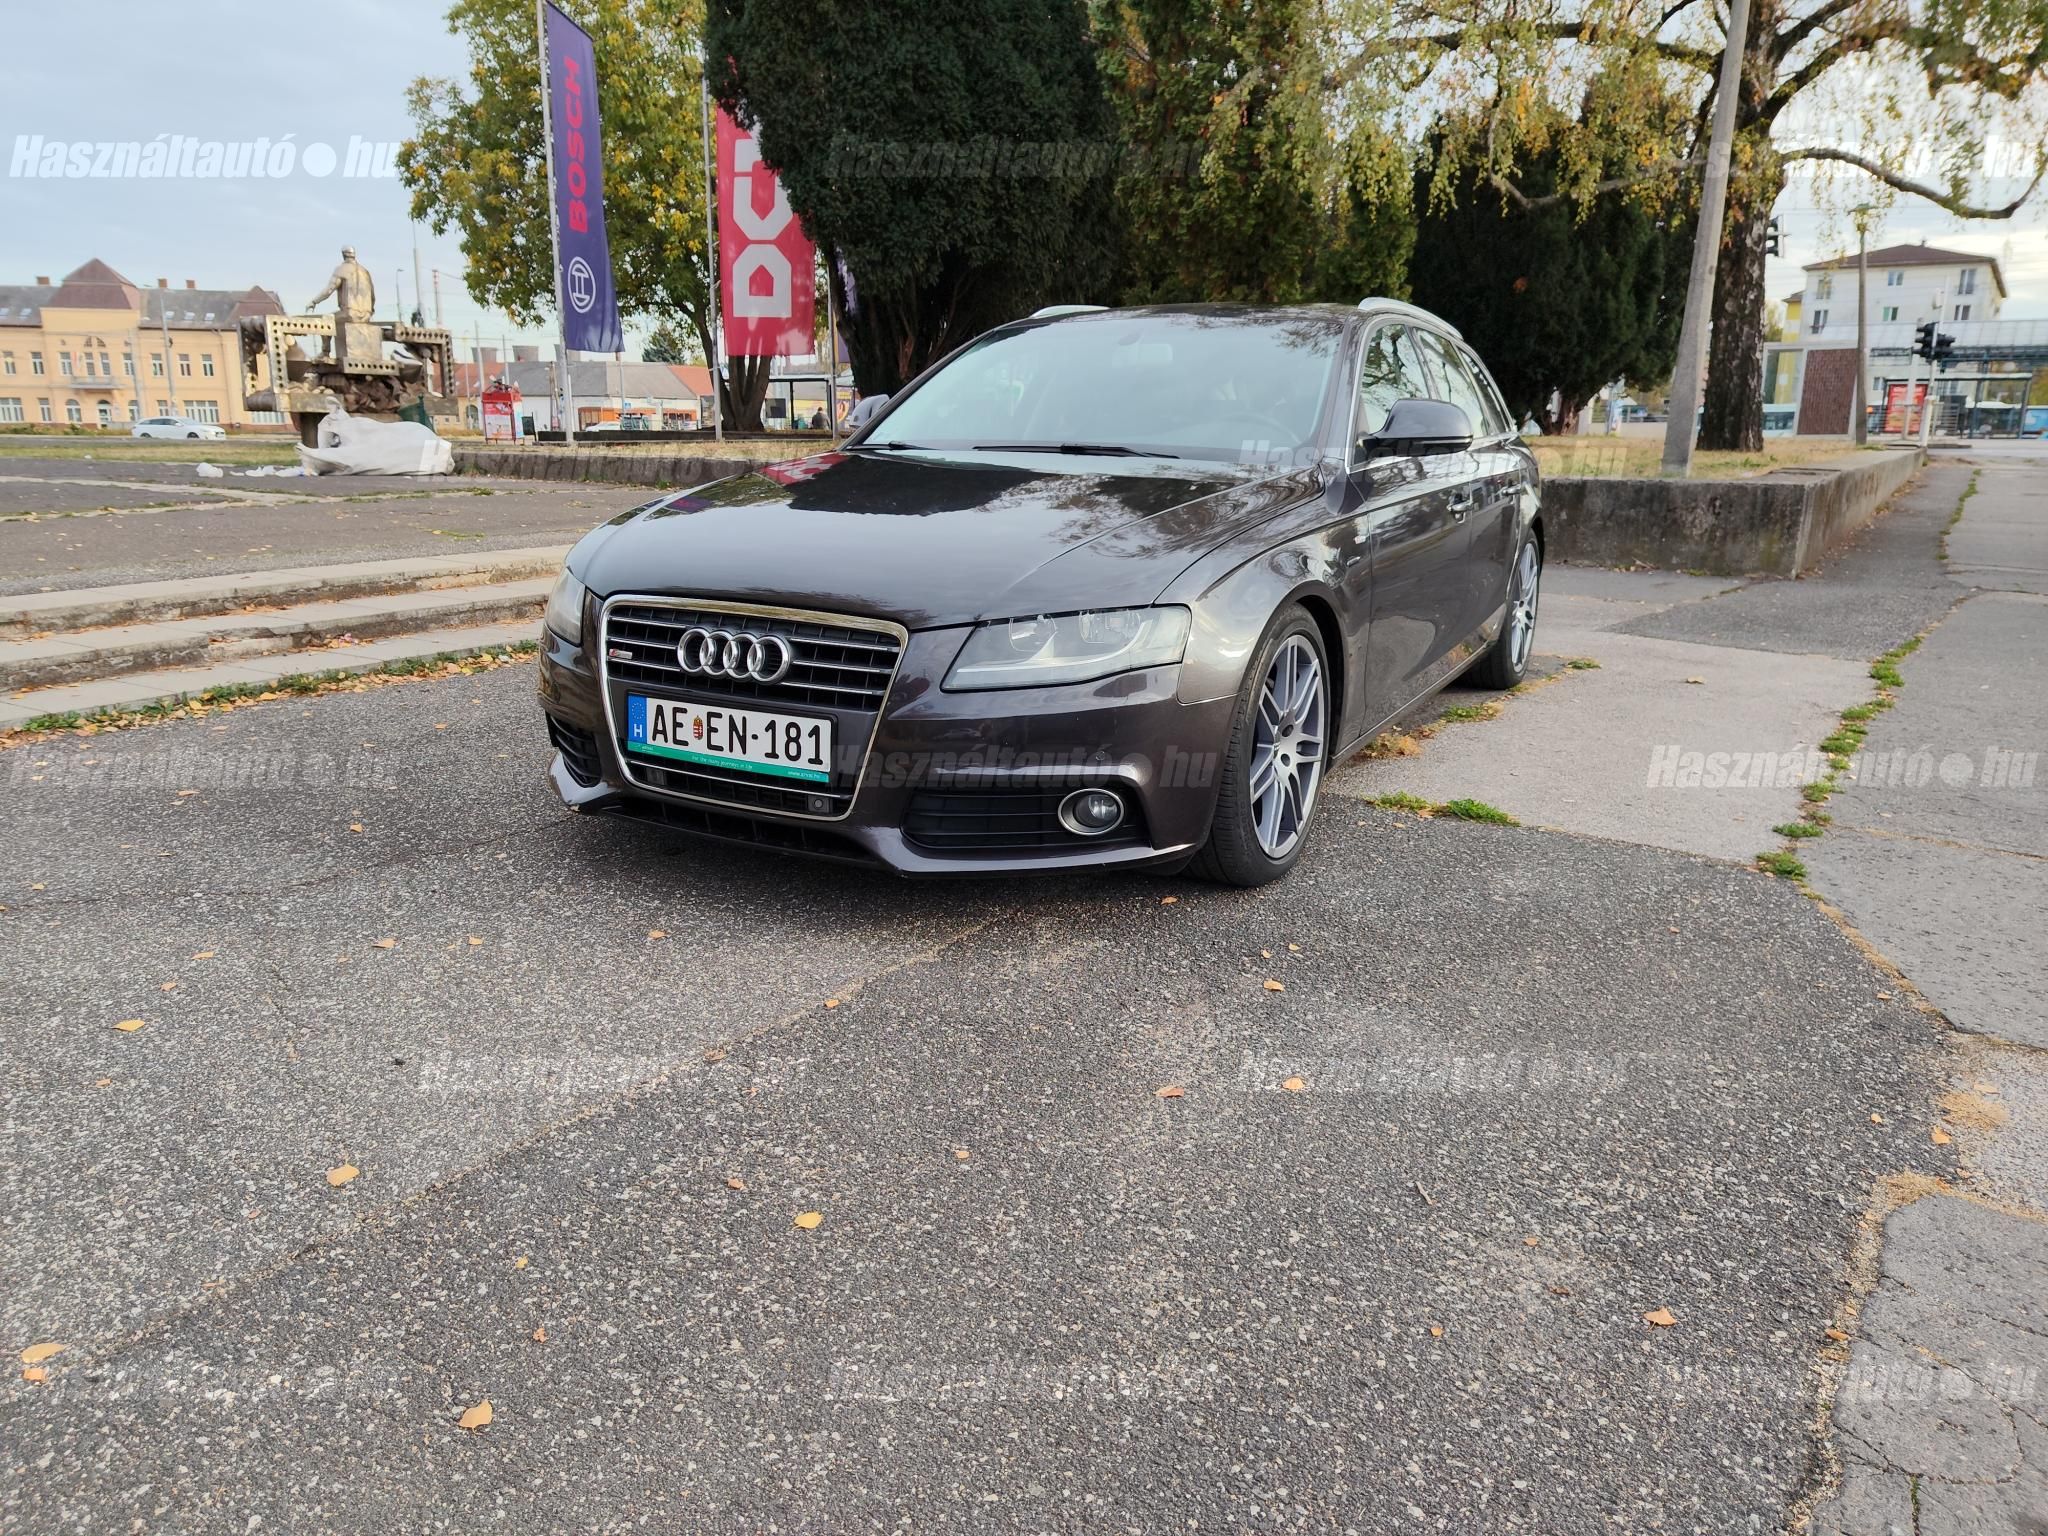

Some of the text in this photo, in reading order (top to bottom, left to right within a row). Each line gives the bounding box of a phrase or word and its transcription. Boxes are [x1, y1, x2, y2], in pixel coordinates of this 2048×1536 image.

[564, 55, 588, 234] BOSCH
[633, 723, 643, 738] H
[651, 704, 824, 766] AE EN-181
